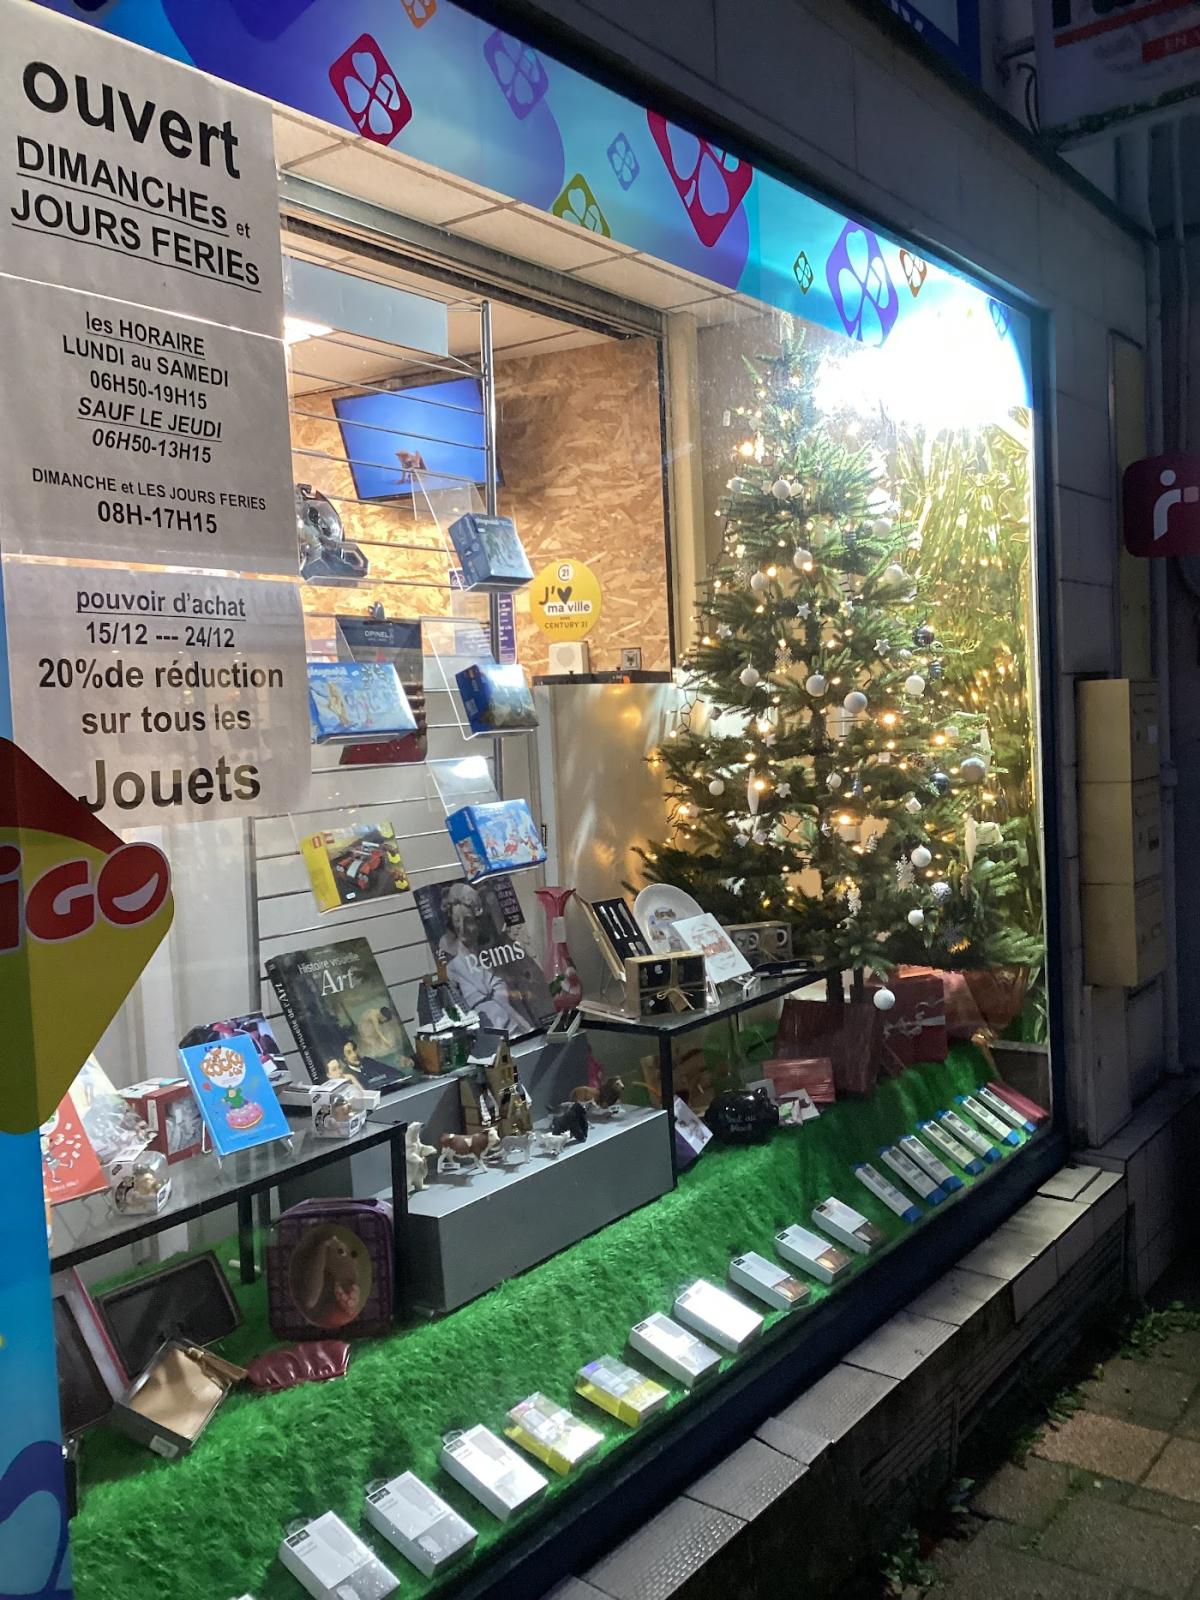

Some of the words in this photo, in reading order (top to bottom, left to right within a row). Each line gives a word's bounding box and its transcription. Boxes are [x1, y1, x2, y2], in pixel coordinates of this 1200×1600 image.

[23, 61, 240, 179] ouvert
[10, 189, 141, 250] JOURS
[236, 222, 251, 238] et
[86, 311, 113, 334] les
[119, 319, 205, 356] HORAIRE
[62, 335, 124, 366] LUNDI
[131, 354, 151, 371] au
[157, 356, 228, 387] SAMEDI
[90, 370, 207, 410] 06H50-19H15
[78, 397, 135, 423] SAUF
[140, 408, 162, 428] LE
[168, 414, 222, 439] JEUDI
[92, 428, 211, 464] 06H50-13H15
[32, 468, 116, 492] DIMANCHE
[121, 482, 134, 494] et
[138, 482, 165, 498] LES
[169, 487, 215, 505] JOURS
[220, 493, 266, 511] FERIES
[97, 501, 218, 534] 08H-17H15
[76, 590, 166, 612] pouvoir
[173, 593, 246, 617] d'achat
[548, 604, 564, 613] ma
[568, 602, 591, 612] ville
[86, 621, 148, 645] 15/12
[185, 626, 235, 648] 24/12
[155, 660, 284, 689] réduction
[82, 712, 131, 735] sur
[142, 706, 206, 733] tous
[215, 704, 251, 731] les
[78, 755, 261, 813] Jouets
[321, 968, 355, 996] Art
